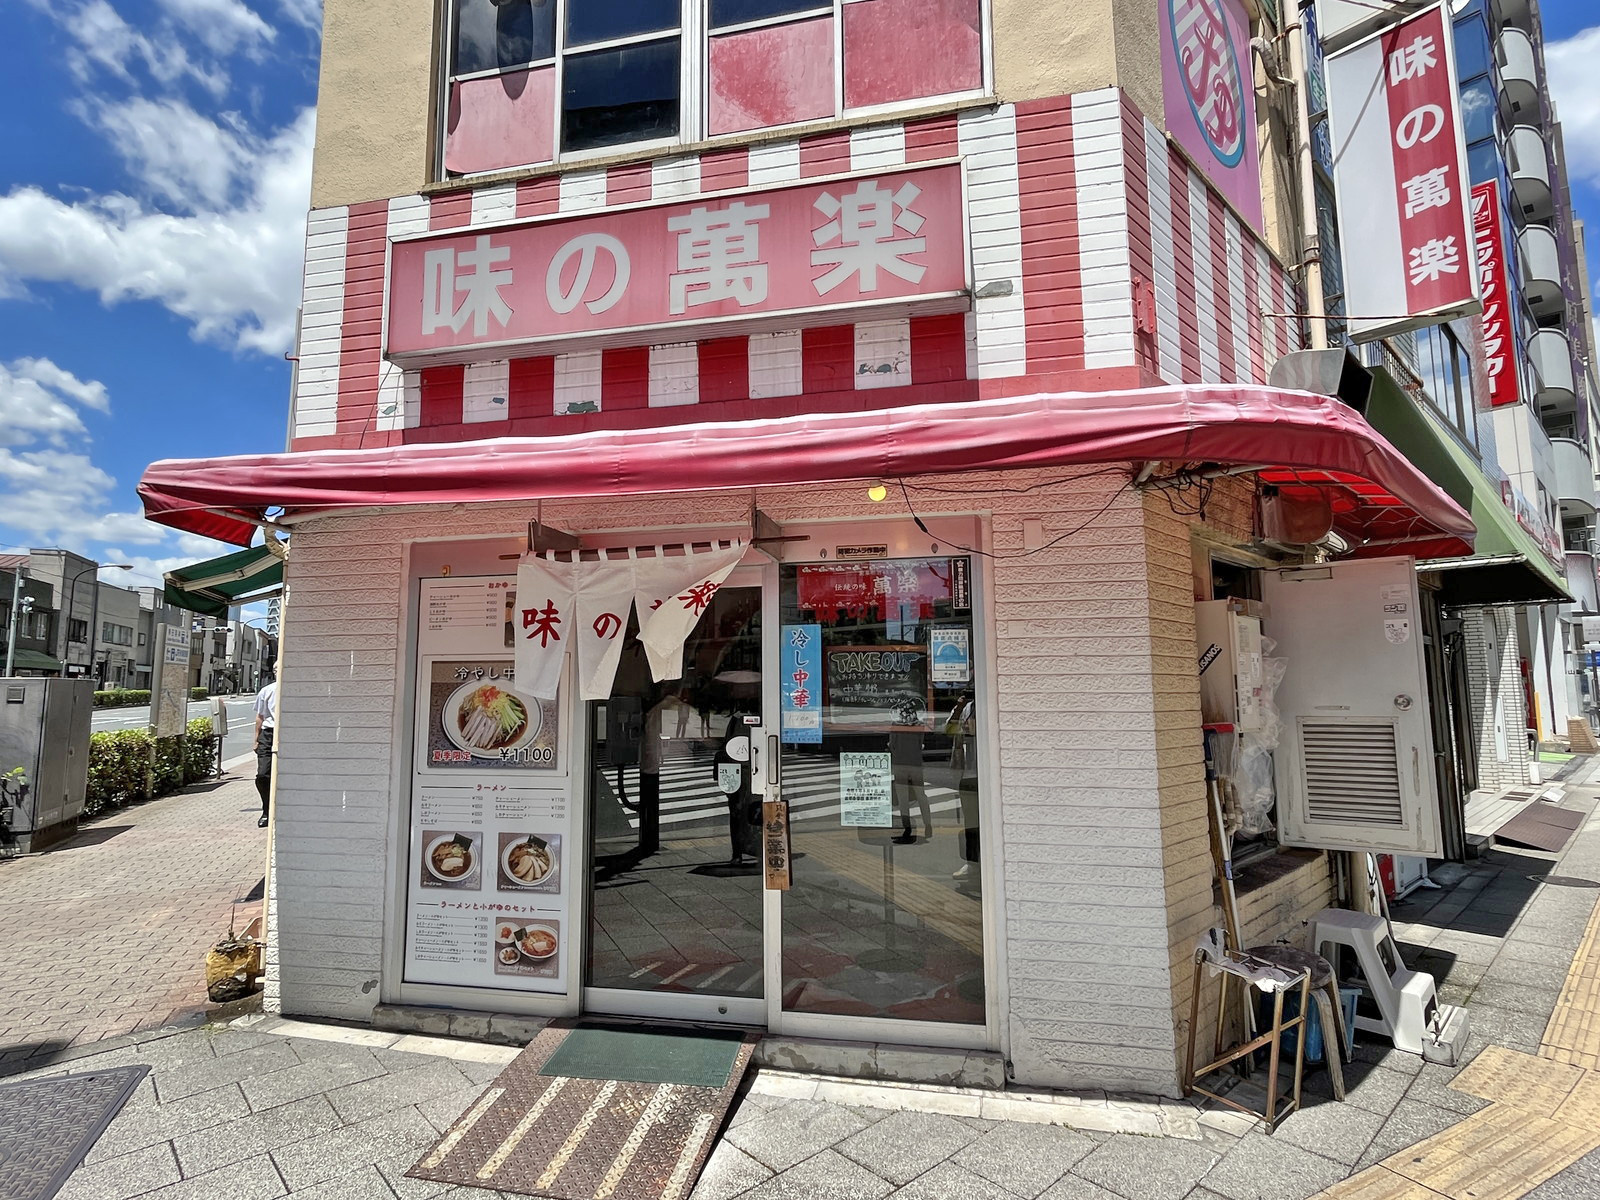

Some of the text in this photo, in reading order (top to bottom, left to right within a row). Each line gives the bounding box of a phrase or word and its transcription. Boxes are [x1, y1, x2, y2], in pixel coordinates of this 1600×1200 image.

[1389, 35, 1460, 287] 味の萬楽
[421, 180, 928, 337] 味の萬楽
[790, 628, 812, 709] 冷し中華
[1198, 643, 1221, 673] USANOS
[433, 748, 552, 761] 夏季限定 ¥1100
[476, 783, 507, 792] ラーメン
[440, 901, 536, 913] ラーメンと小がゆのセット
